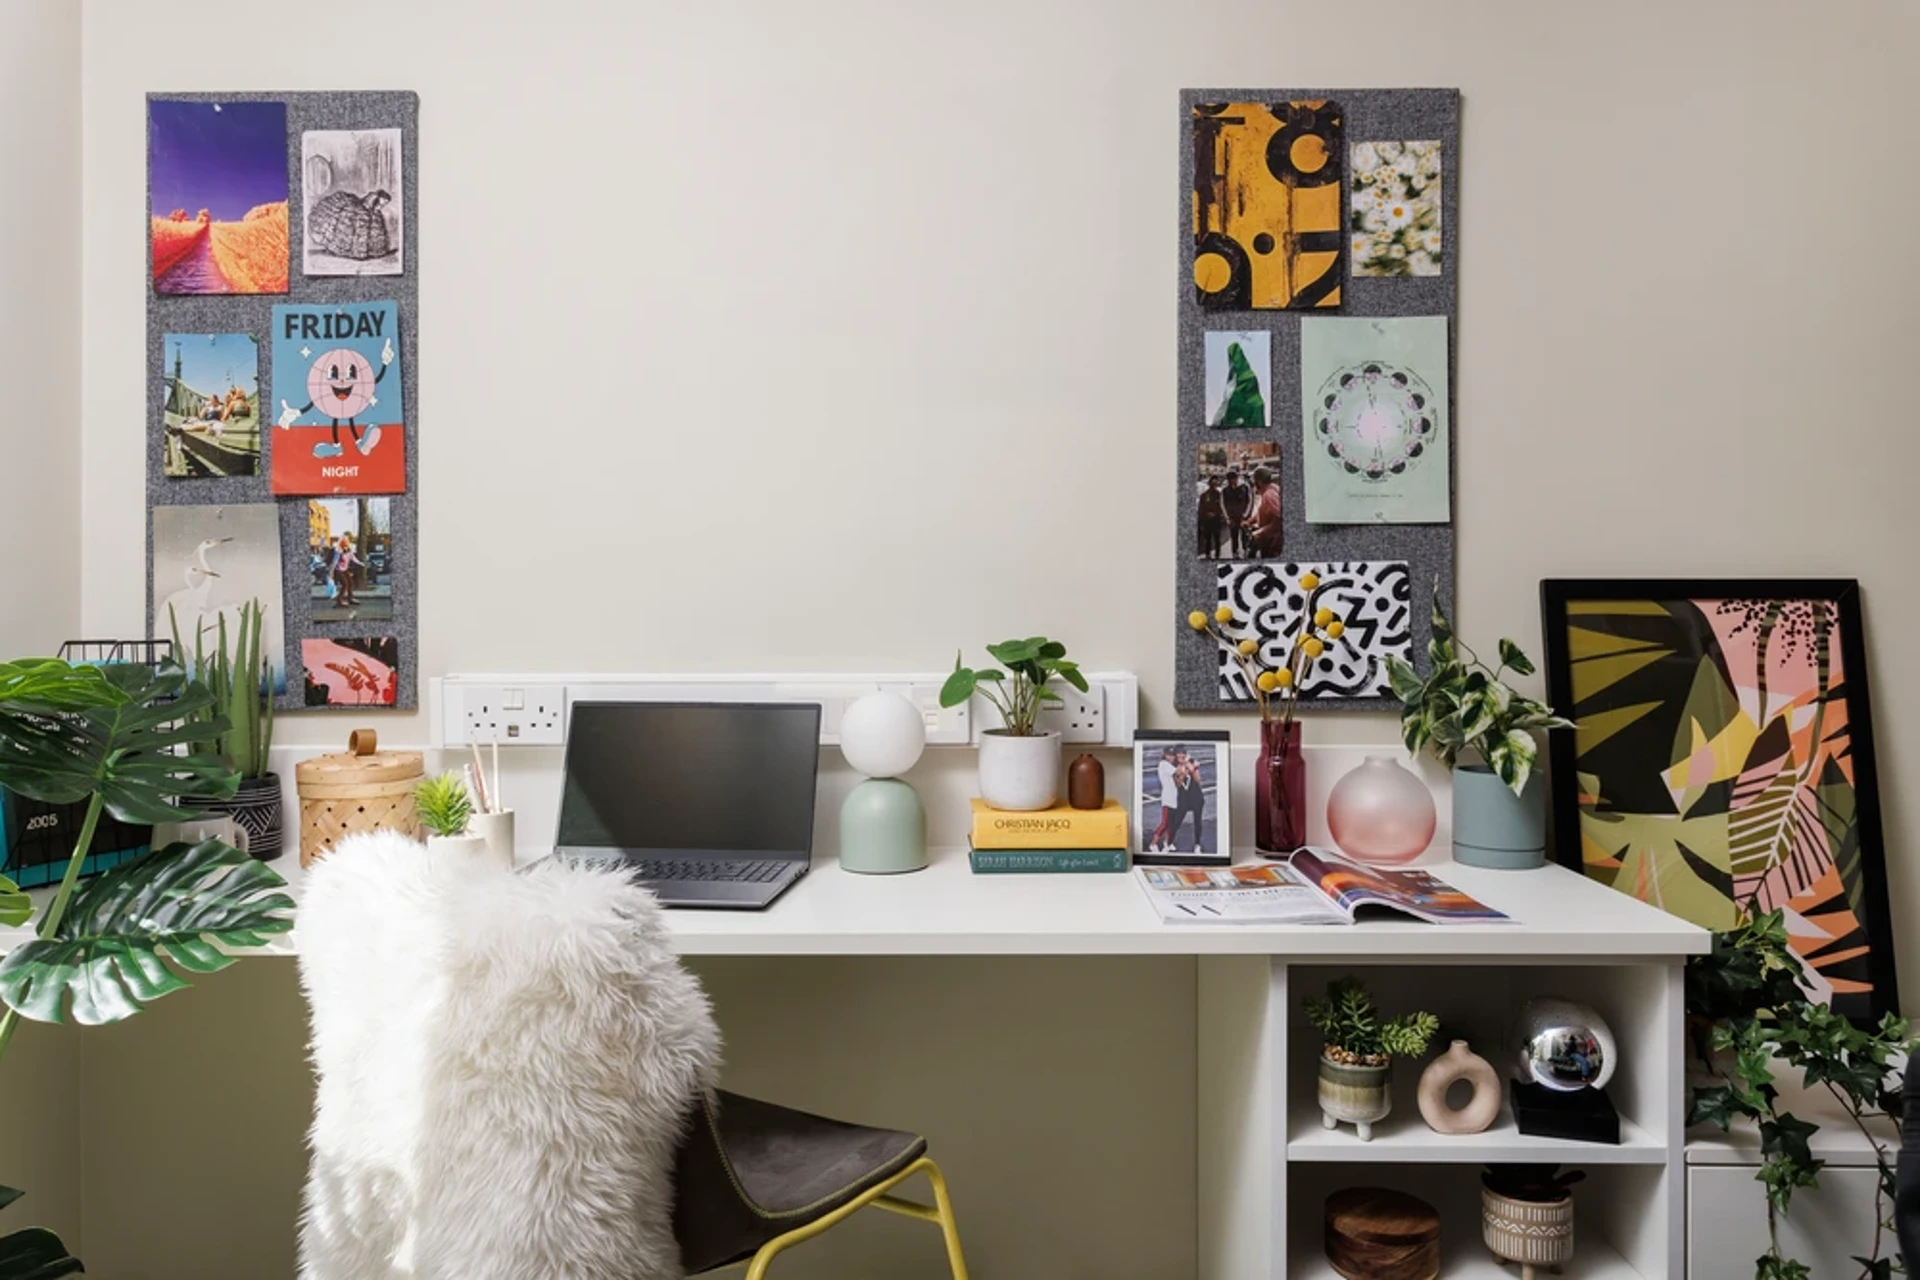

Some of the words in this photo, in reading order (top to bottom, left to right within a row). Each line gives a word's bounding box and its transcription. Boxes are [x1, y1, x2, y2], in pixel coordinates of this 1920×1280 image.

[284, 311, 386, 340] FRIDAY
[322, 466, 359, 478] NIGHT
[26, 813, 58, 830] 2005
[994, 818, 1045, 830] CHRISTIAN
[1045, 818, 1071, 831] JACQ
